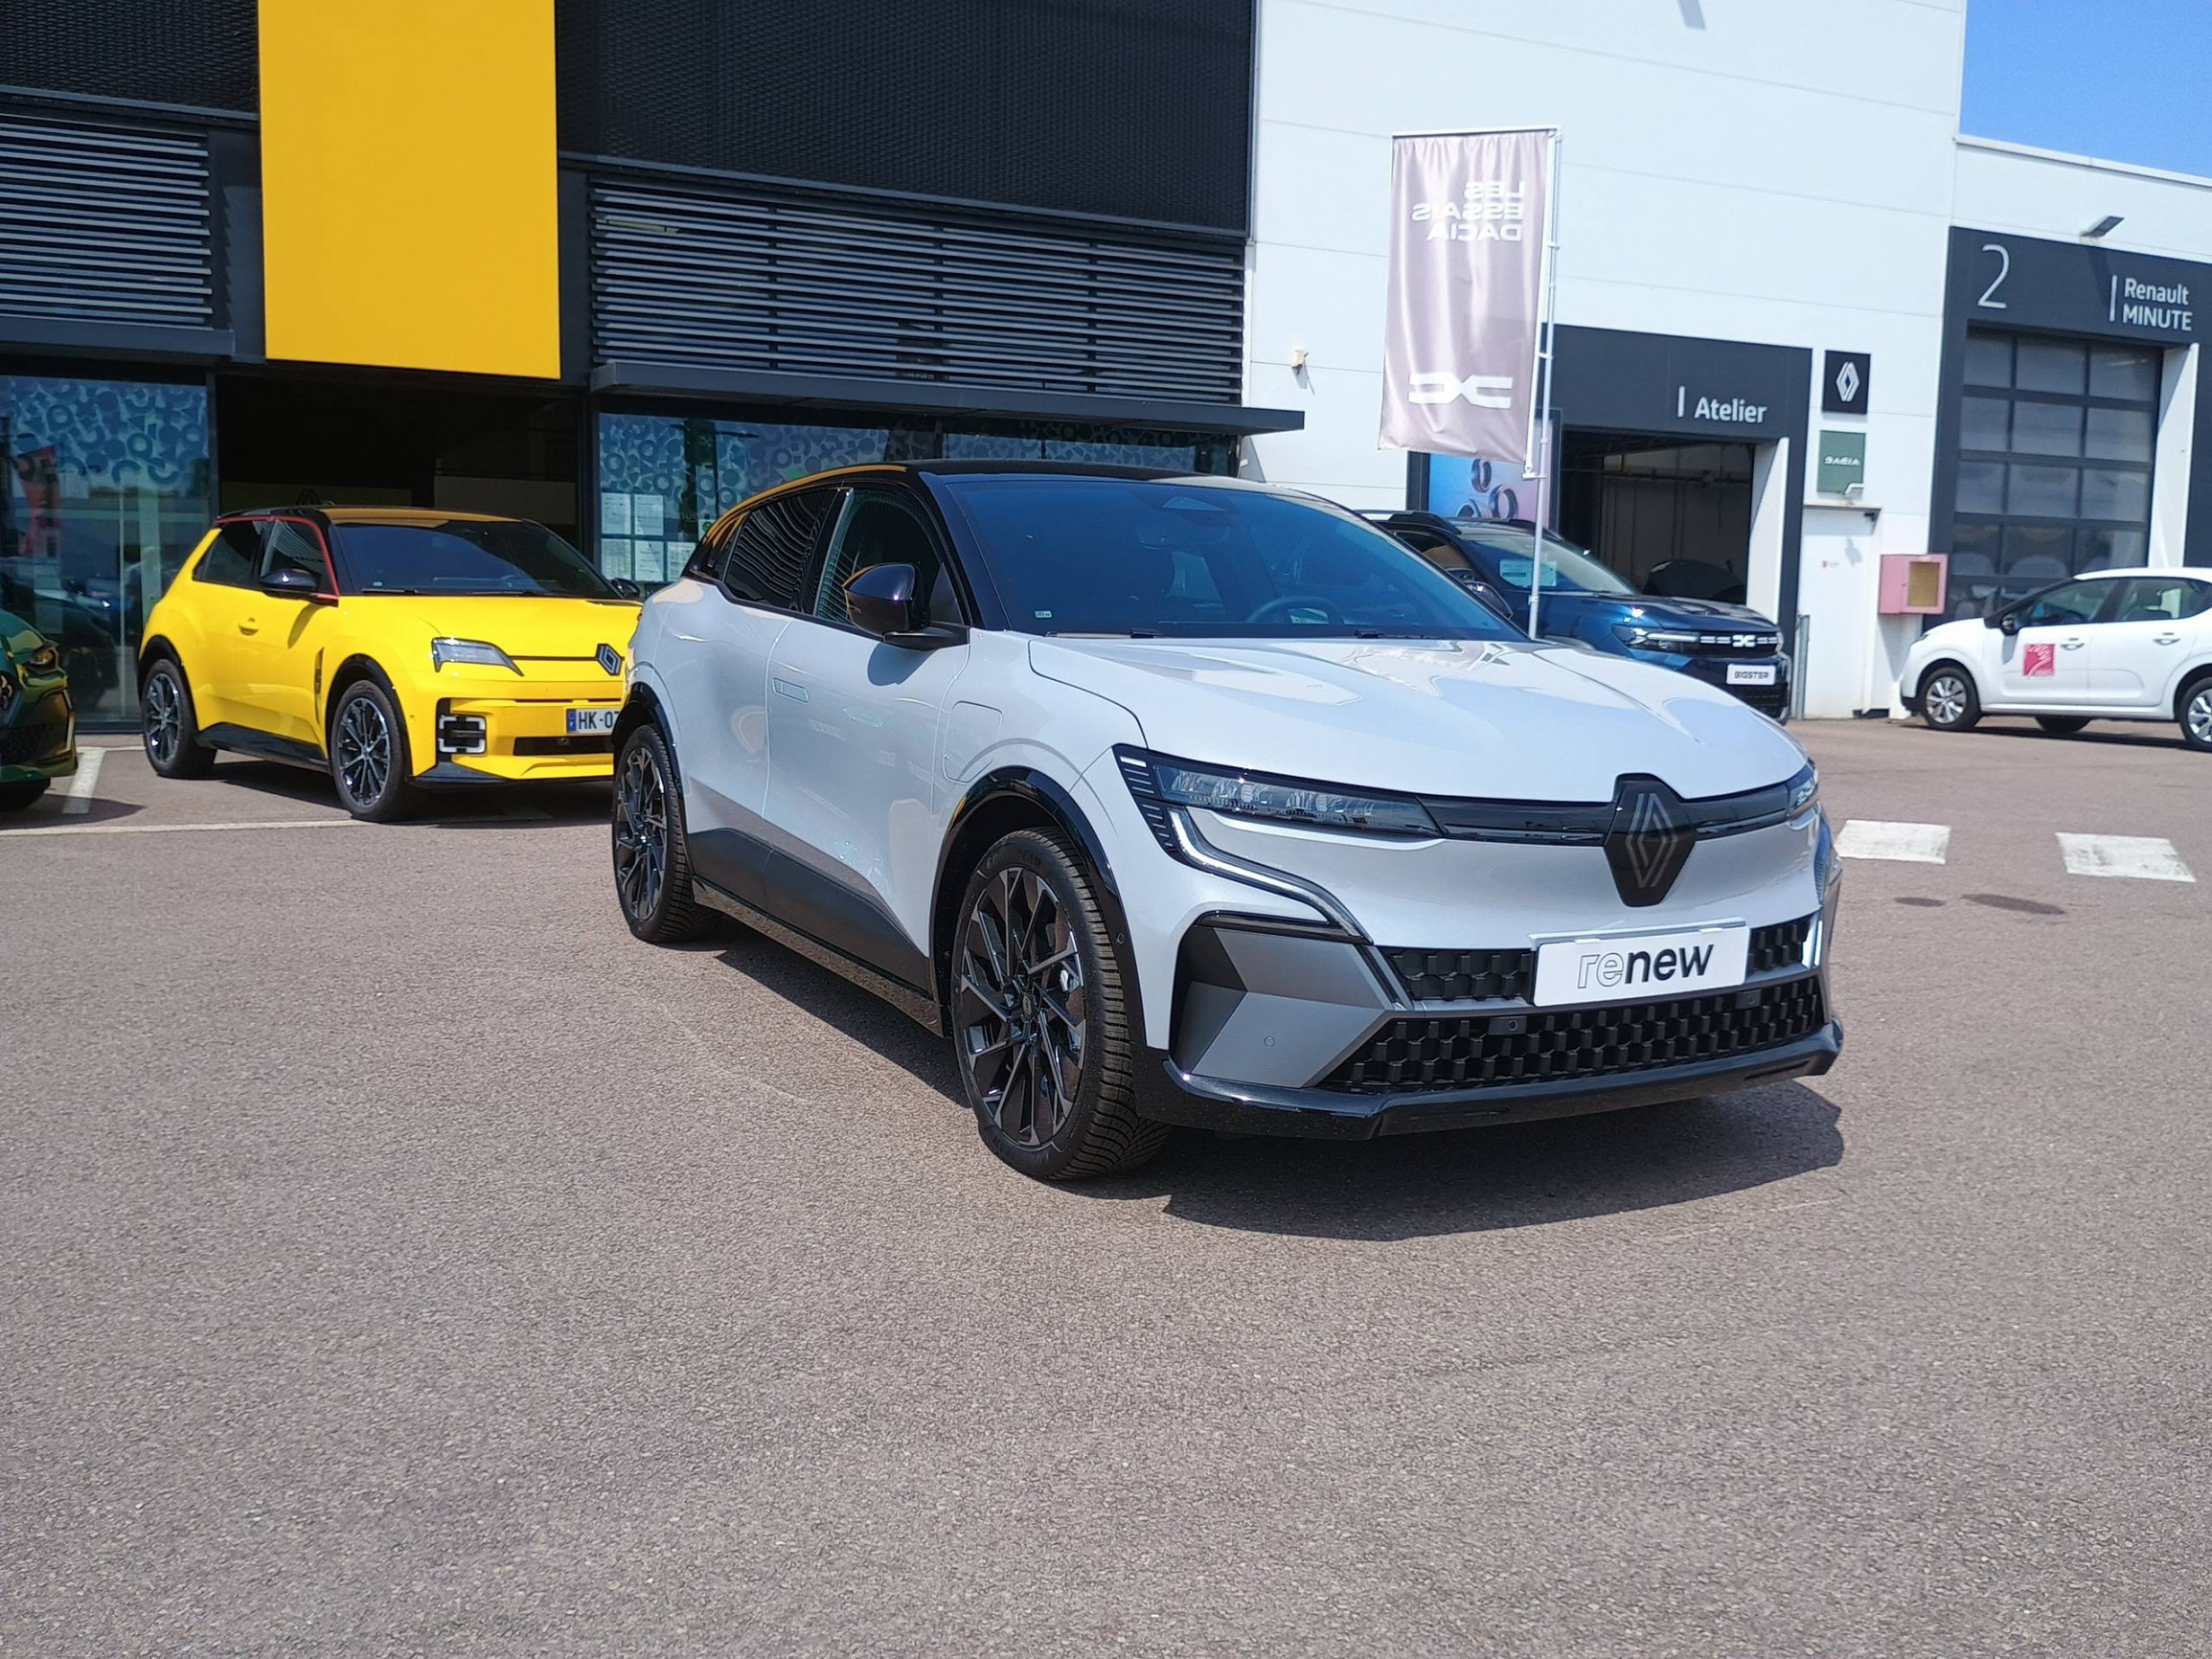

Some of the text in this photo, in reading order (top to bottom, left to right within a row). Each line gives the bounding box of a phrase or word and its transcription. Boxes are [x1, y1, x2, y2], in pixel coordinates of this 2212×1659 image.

[1977, 243, 2010, 309] 2
[2124, 277, 2189, 305] Renault
[2122, 305, 2193, 331] MINUTE
[1694, 396, 1767, 422] Atelier
[1577, 943, 1715, 989] renew
